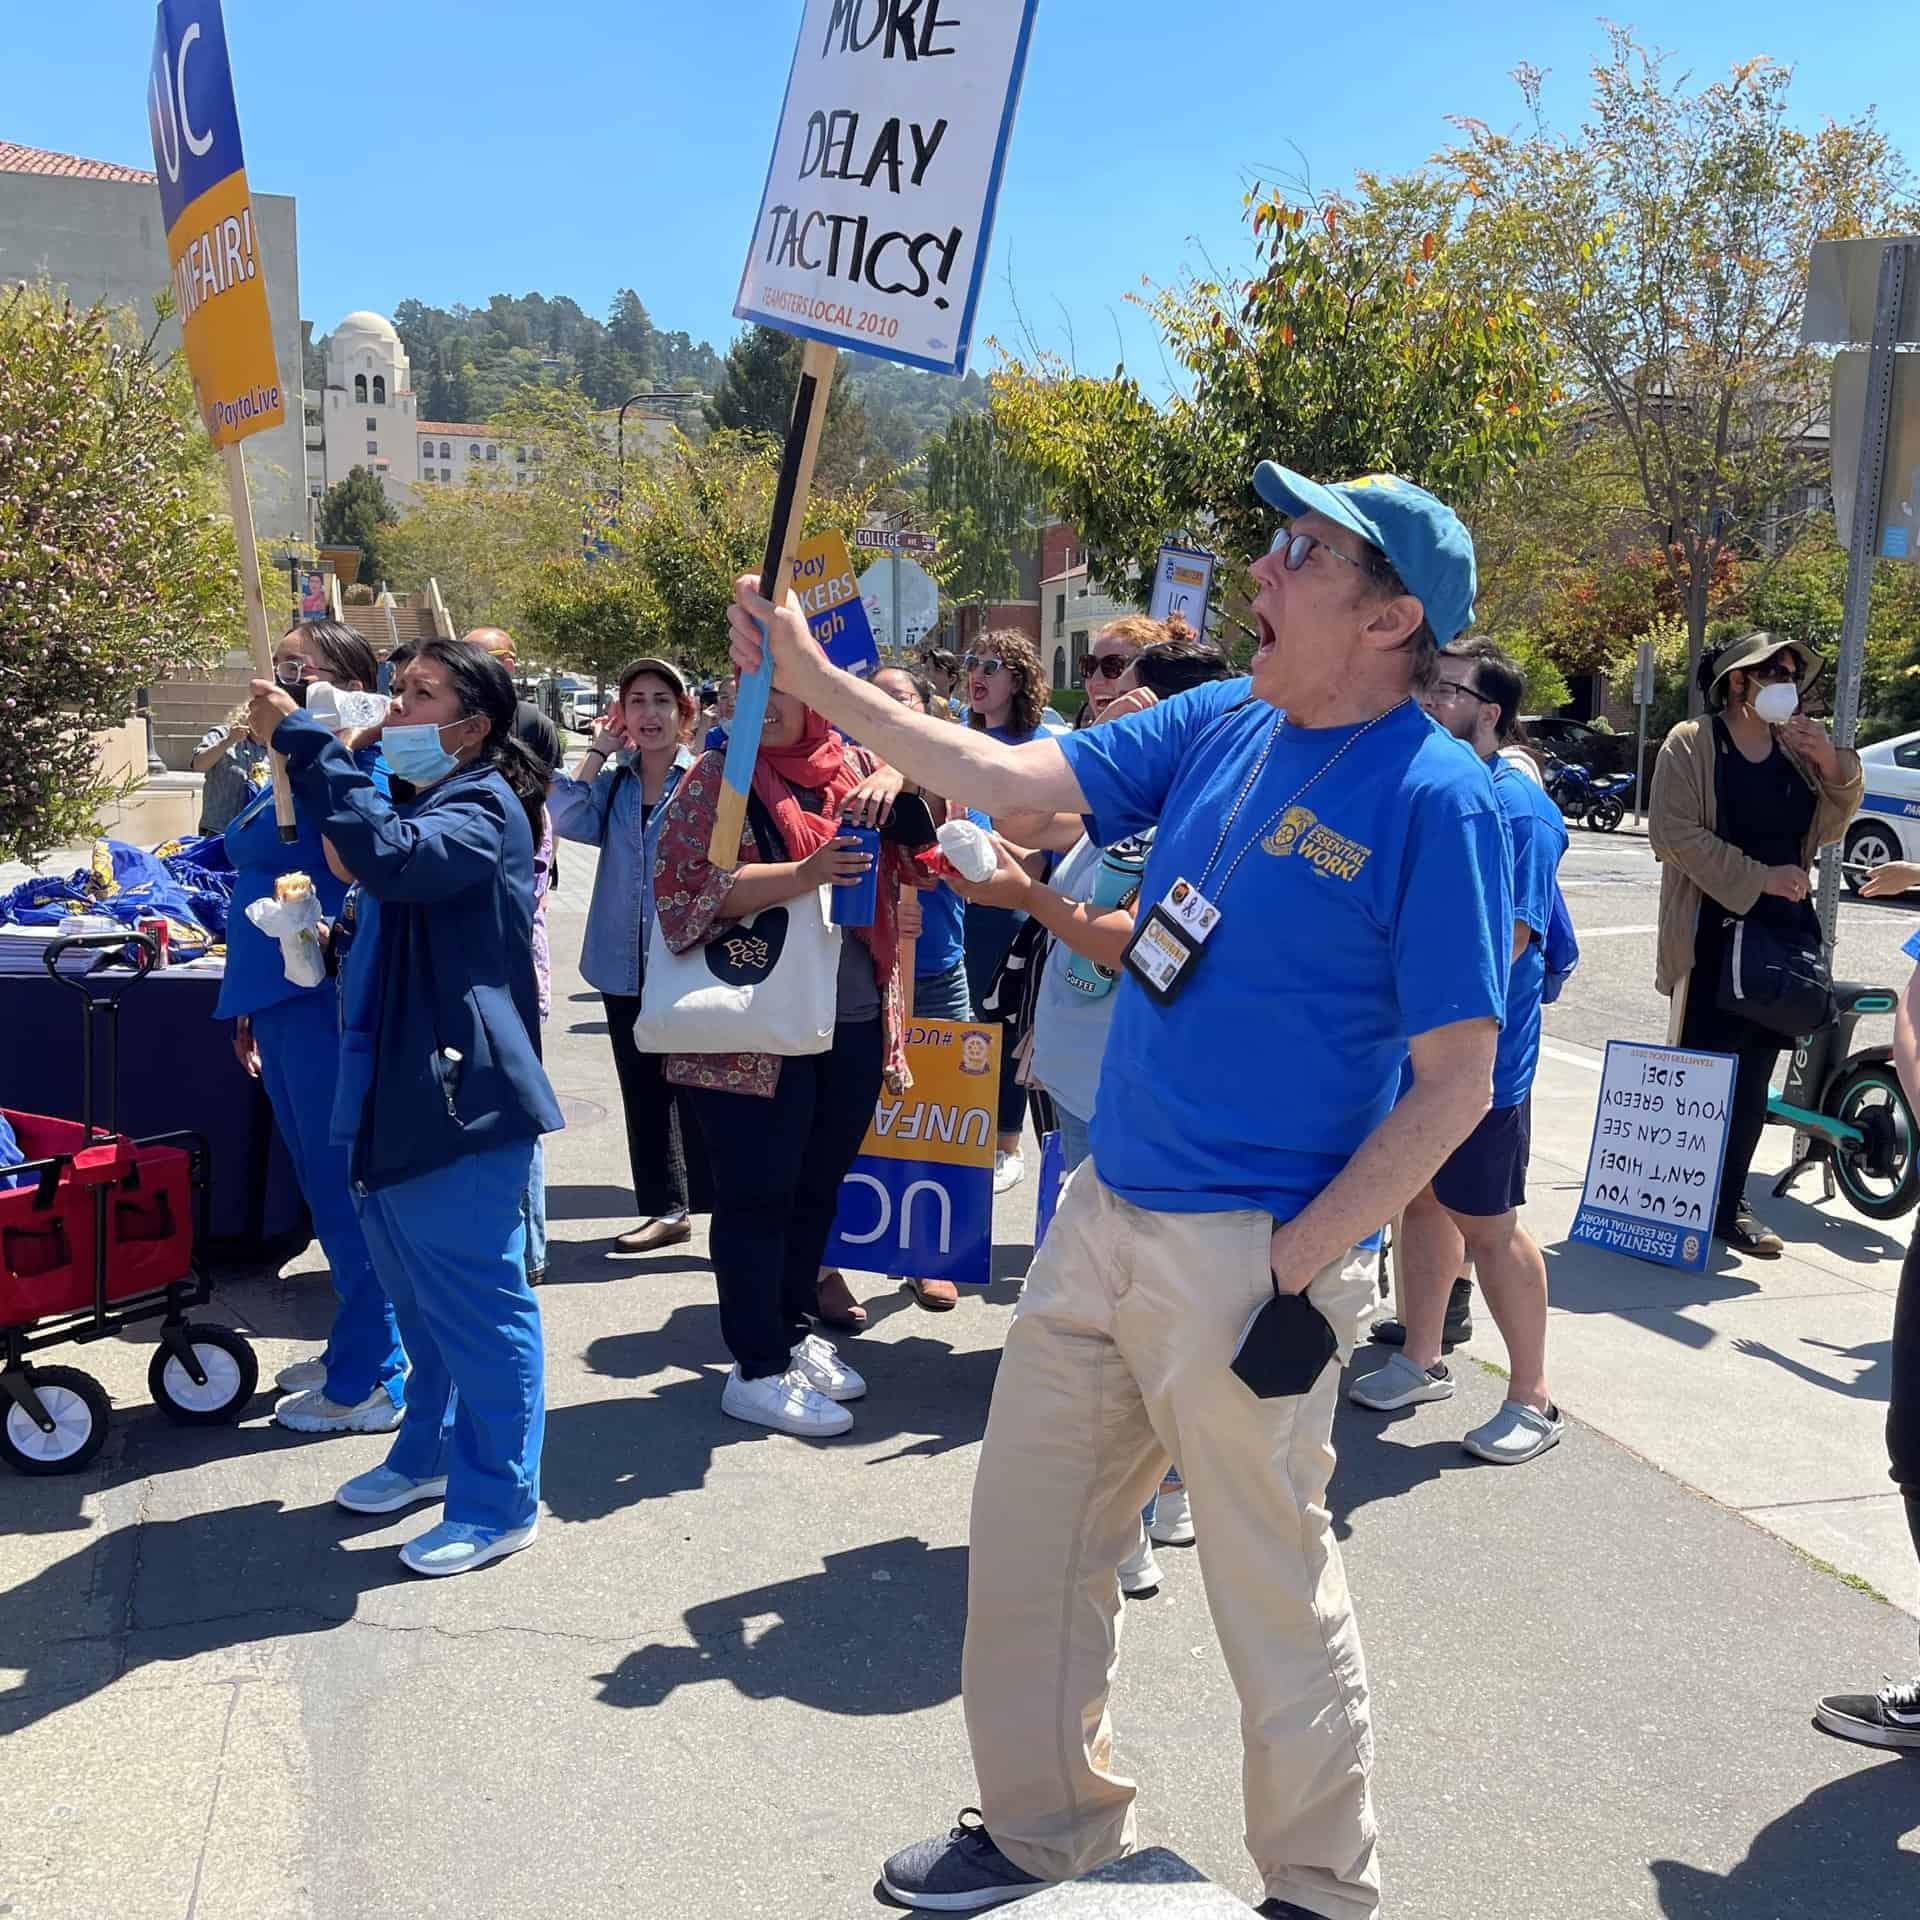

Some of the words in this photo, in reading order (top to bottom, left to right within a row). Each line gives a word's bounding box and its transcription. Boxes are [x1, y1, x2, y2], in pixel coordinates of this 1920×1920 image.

[822, 0, 960, 61] MORE
[153, 22, 214, 183] UC
[798, 109, 948, 194] DELAY
[173, 207, 255, 326] UNFAIR!
[766, 203, 963, 310] TACTICS!
[761, 286, 808, 317] TEAMSTERS
[808, 301, 854, 330] LOCAL
[856, 311, 899, 339] 2010
[857, 531, 901, 547] COLLEGE
[792, 554, 825, 581] Pay
[1298, 839, 1361, 882] WORK!
[1307, 829, 1367, 867] ESSENTIAL
[1065, 968, 1096, 993] COFFEE
[1641, 1063, 1686, 1087] SIDE!
[1603, 1089, 1664, 1112] GREEDY
[1675, 1098, 1727, 1121] YOUR
[1602, 1118, 1632, 1138] SEE
[1637, 1125, 1672, 1145] CAN
[1676, 1130, 1706, 1152] WE
[1599, 1149, 1643, 1176] HIDE!
[1648, 1165, 1706, 1187] CAN'T
[1595, 1184, 1630, 1206] YOU
[1636, 1188, 1666, 1214] UC,
[840, 1173, 951, 1253] UC
[1672, 1195, 1702, 1221] UC,
[1574, 1223, 1604, 1241] PAY
[1579, 1213, 1609, 1229] WORK
[1610, 1220, 1658, 1239] ESSENTIAL
[1606, 1230, 1676, 1258] ESSENTIAL
[1658, 1231, 1678, 1243] FOR
